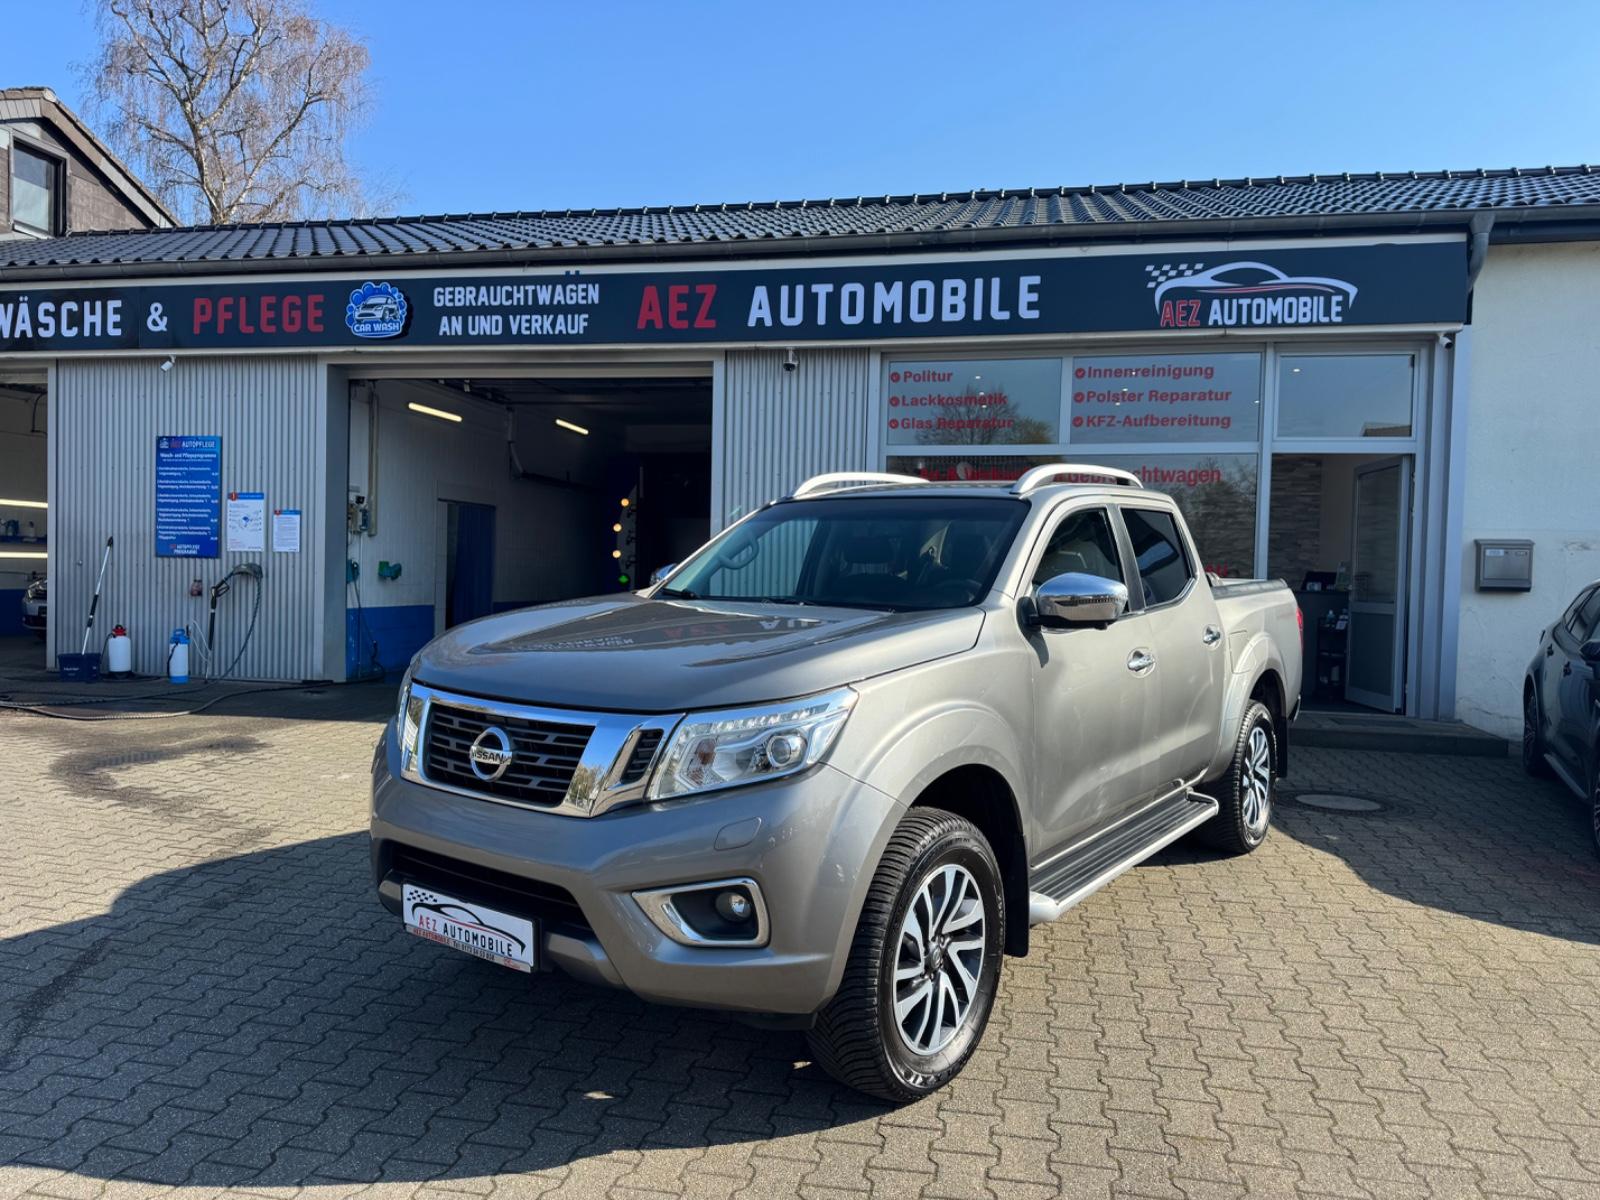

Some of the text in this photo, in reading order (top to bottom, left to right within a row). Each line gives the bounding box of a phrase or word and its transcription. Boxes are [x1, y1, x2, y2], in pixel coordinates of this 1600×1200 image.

[636, 275, 1042, 330] AEZ AUTOMOBILE
[146, 302, 168, 332] &
[193, 295, 325, 335] PFLEGE
[1160, 295, 1343, 327] AEZ AUTOMOBILE
[354, 322, 400, 332] CAR WASH
[438, 313, 589, 336] AN UND VERKAUF
[903, 370, 953, 383] Politur
[1087, 364, 1215, 380] Innenreinigung
[901, 392, 1009, 407] Lackkosmetik
[1086, 389, 1232, 404] Polster Reparatur
[901, 418, 933, 430] Glas
[1086, 414, 1232, 429] KFZ-Aufbereitung
[418, 915, 437, 931] AEZ
[443, 922, 513, 957] AUTOMOBILE
